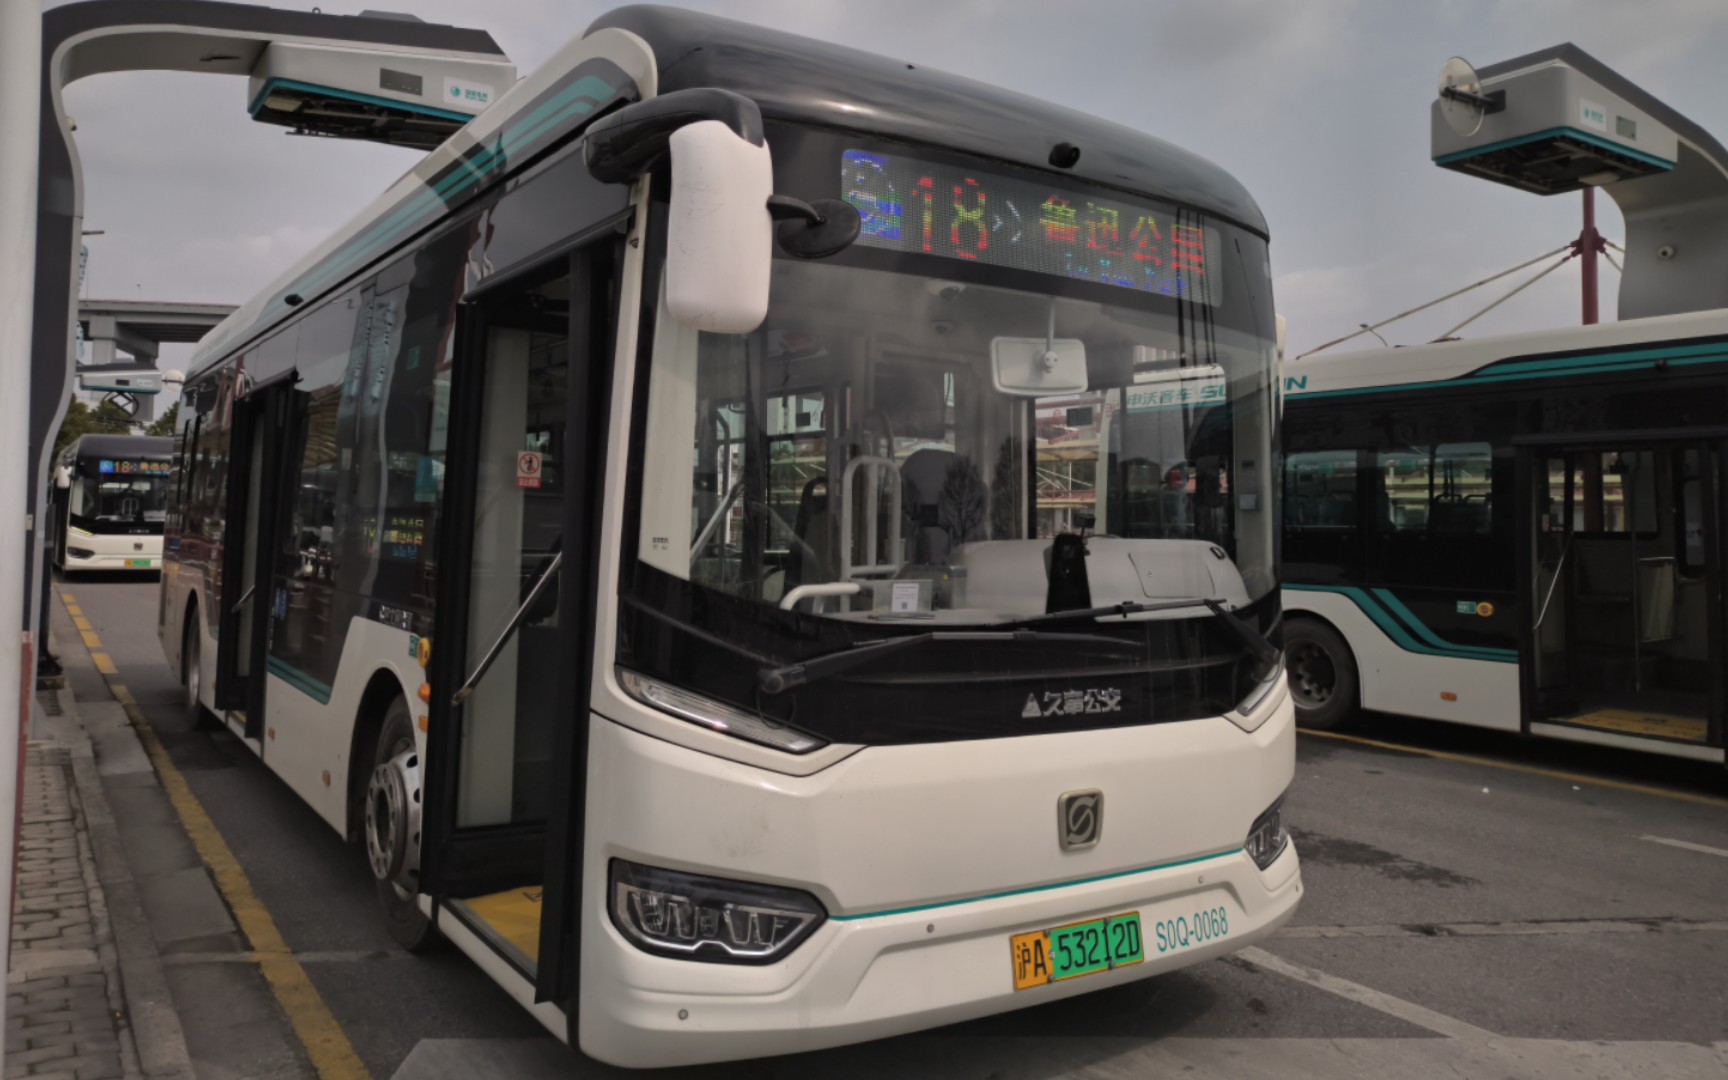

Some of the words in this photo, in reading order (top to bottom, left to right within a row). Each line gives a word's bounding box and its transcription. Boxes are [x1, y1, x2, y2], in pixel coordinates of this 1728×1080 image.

[911, 176, 989, 260] 18
[114, 460, 130, 474] 18
[1042, 687, 1121, 717] 久事公交
